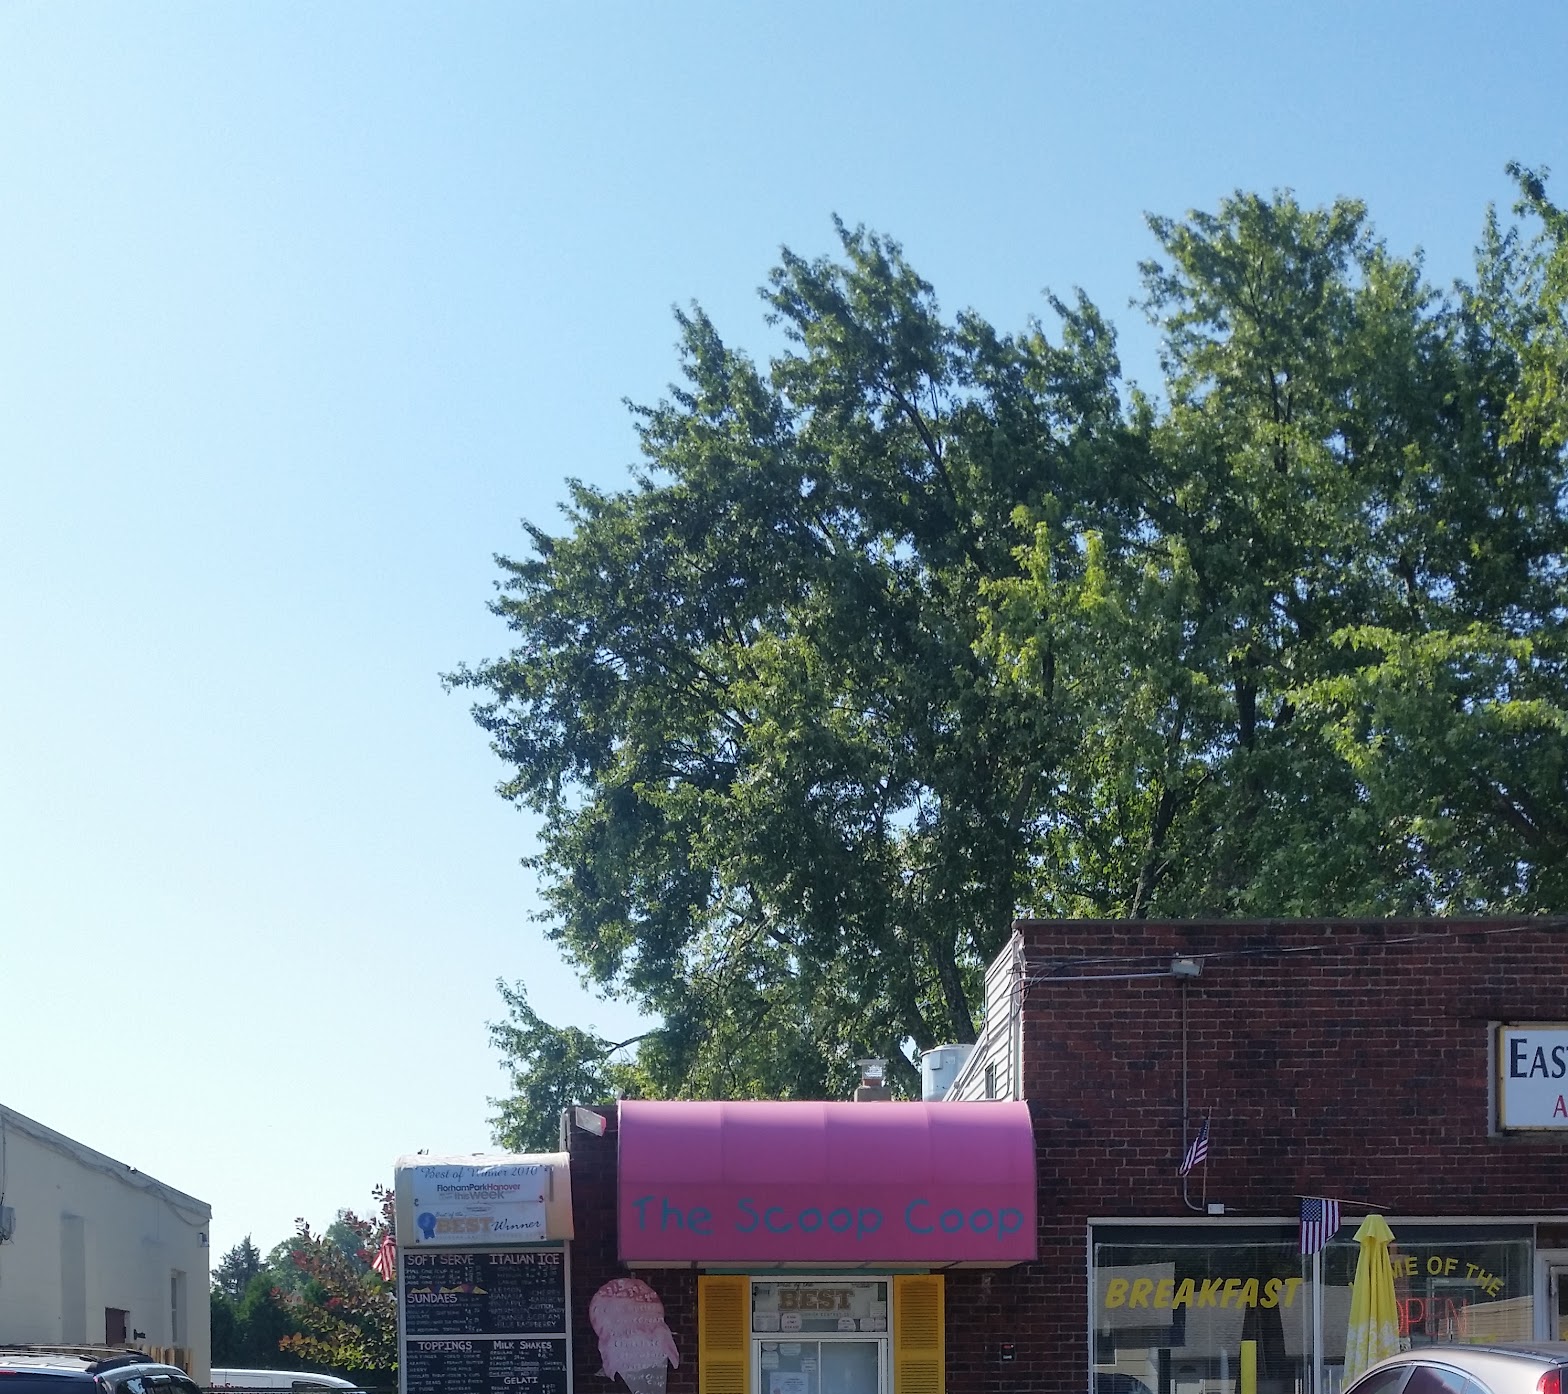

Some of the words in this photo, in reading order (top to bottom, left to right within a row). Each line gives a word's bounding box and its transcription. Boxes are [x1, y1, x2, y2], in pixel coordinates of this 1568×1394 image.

[1510, 1038, 1568, 1079] EAS
[421, 1167, 450, 1179] Best
[452, 1166, 464, 1182] of
[436, 1217, 493, 1233] BEST
[491, 1218, 541, 1231] Winner
[632, 1195, 714, 1235] The
[735, 1197, 885, 1241] Scoop
[904, 1199, 1025, 1241] Coop
[407, 1254, 437, 1266] SOFT
[440, 1254, 475, 1265] SERVE
[489, 1254, 535, 1265] ITALIAN
[537, 1253, 560, 1265] ICE
[1426, 1256, 1459, 1277] OF
[1465, 1262, 1505, 1298] THE
[407, 1293, 458, 1304] SUNDAES
[777, 1288, 855, 1311] BEST
[1105, 1277, 1304, 1310] BREAKFAST
[417, 1341, 473, 1350] TOPPINGS
[493, 1340, 515, 1350] MILK
[519, 1340, 552, 1350] SHAKES
[504, 1376, 539, 1384] GELATI
